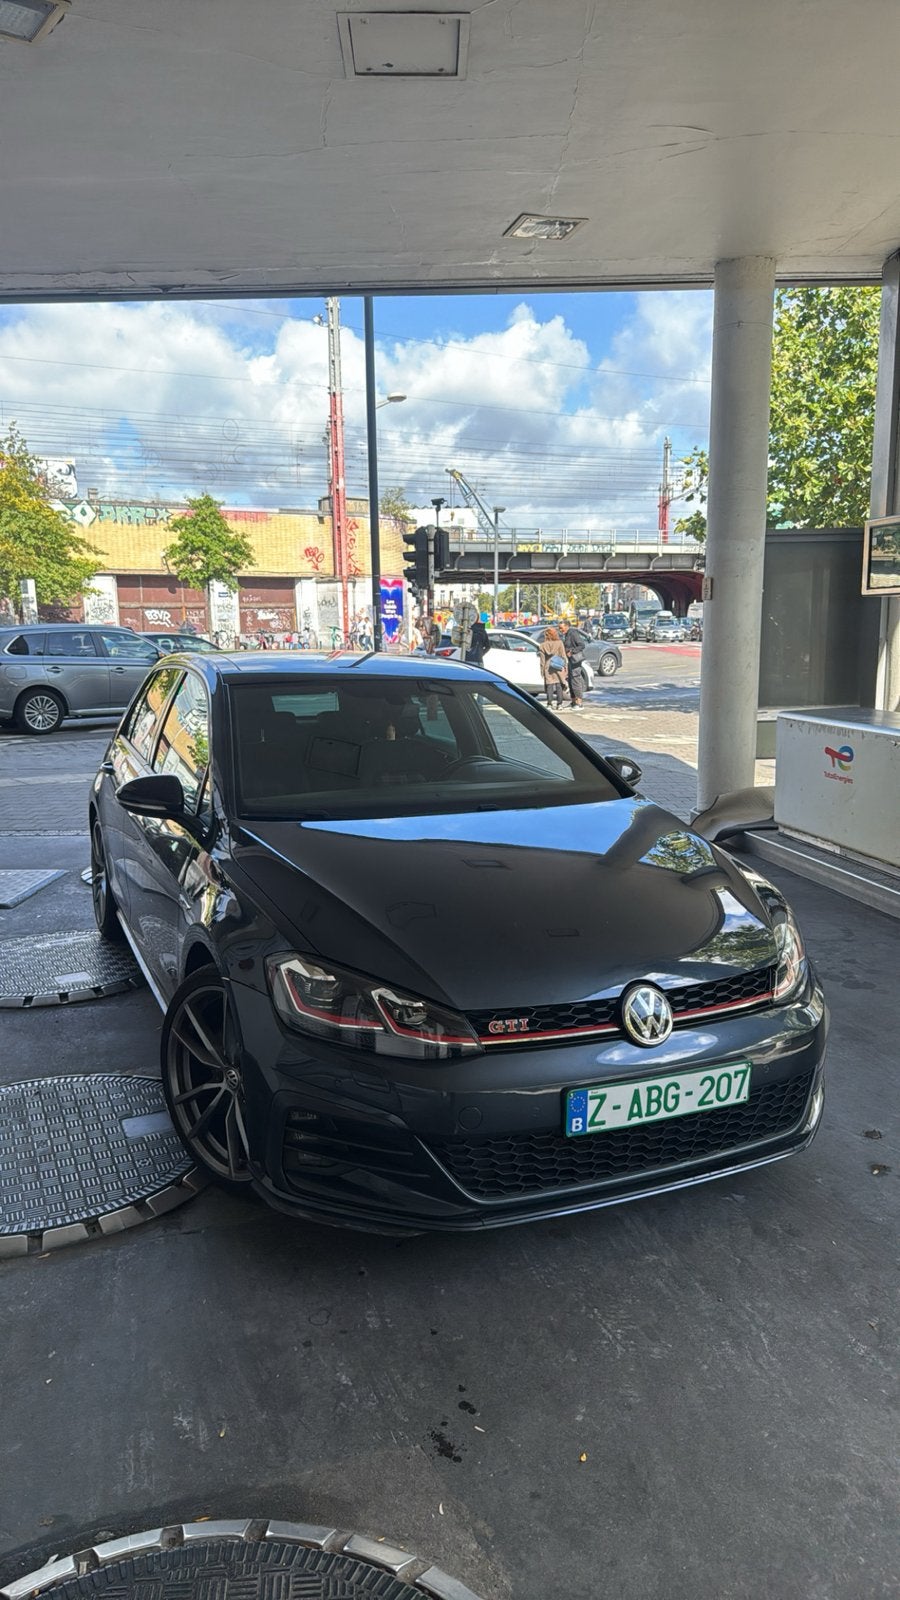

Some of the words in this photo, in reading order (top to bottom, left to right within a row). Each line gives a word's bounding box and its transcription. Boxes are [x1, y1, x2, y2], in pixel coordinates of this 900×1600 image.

[488, 1018, 529, 1034] GTI
[588, 1069, 748, 1127] Z-ABG-207
[572, 1118, 583, 1132] B
